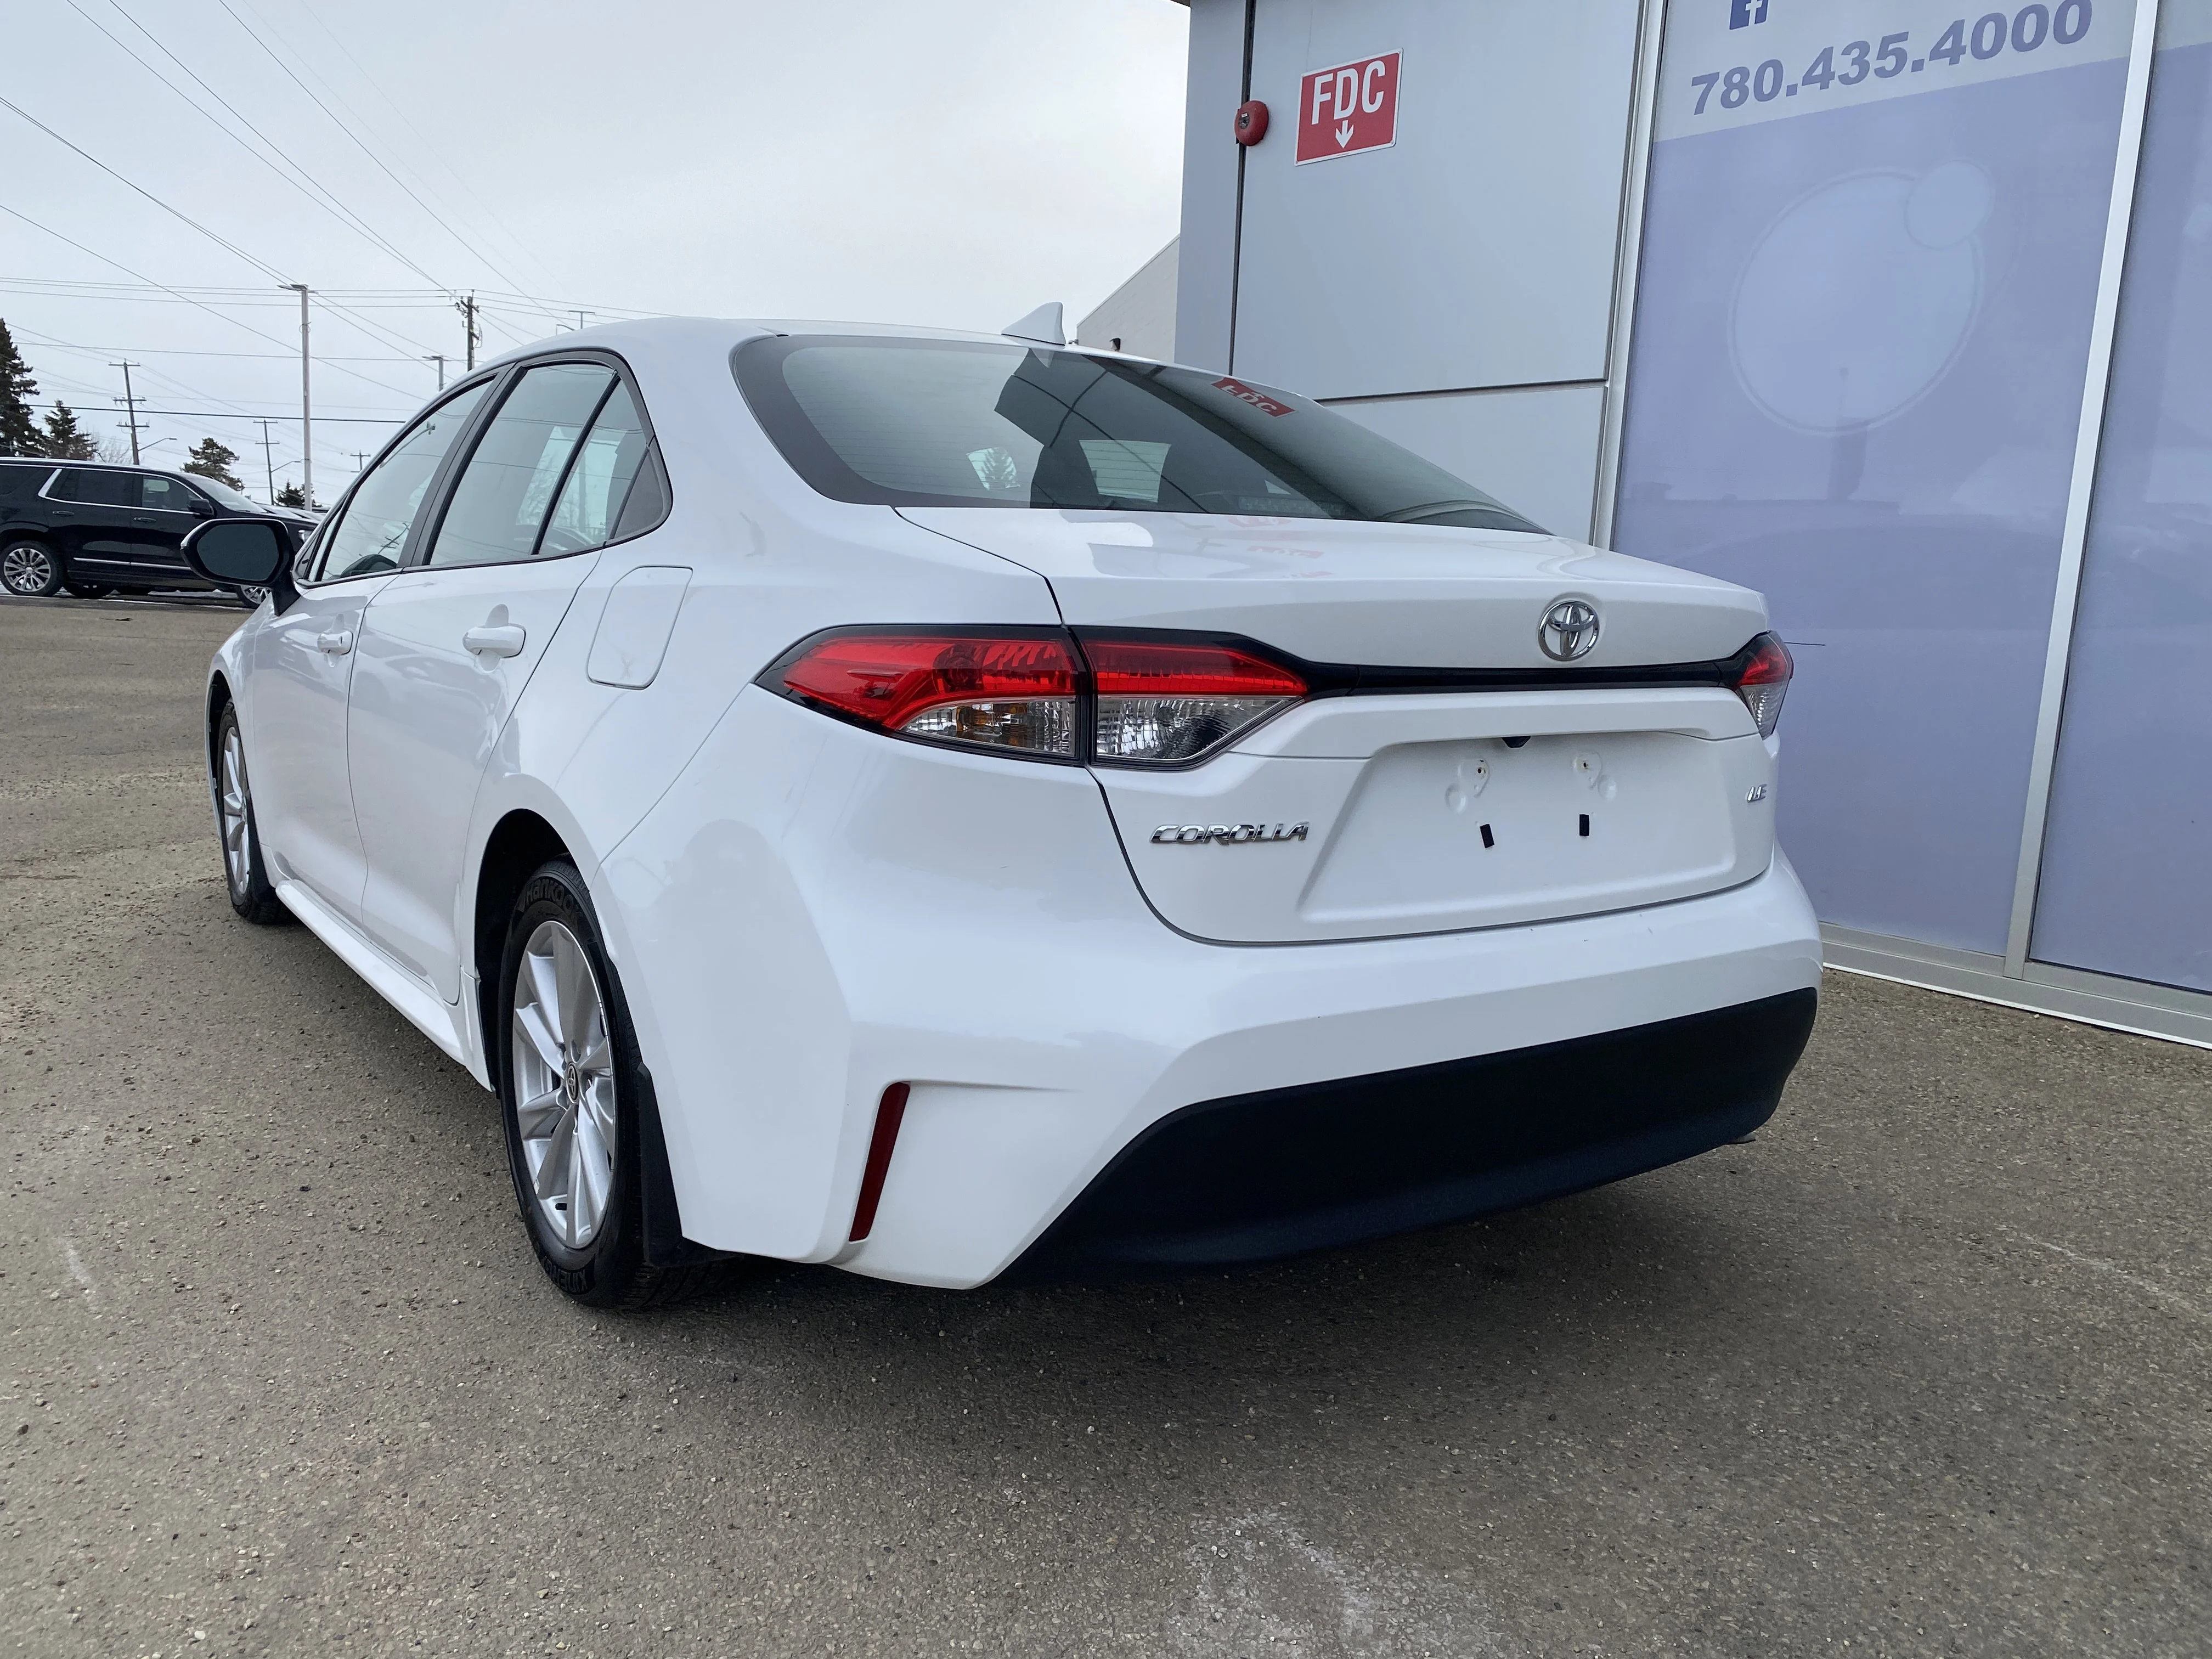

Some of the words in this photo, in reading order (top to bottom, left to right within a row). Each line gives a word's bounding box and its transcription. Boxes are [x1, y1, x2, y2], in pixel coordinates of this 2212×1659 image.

[1691, 0, 2092, 115] 780.435.4000
[1311, 60, 1386, 125] FDC
[1747, 784, 1767, 803] LE
[1150, 821, 1310, 845] COROLLA
